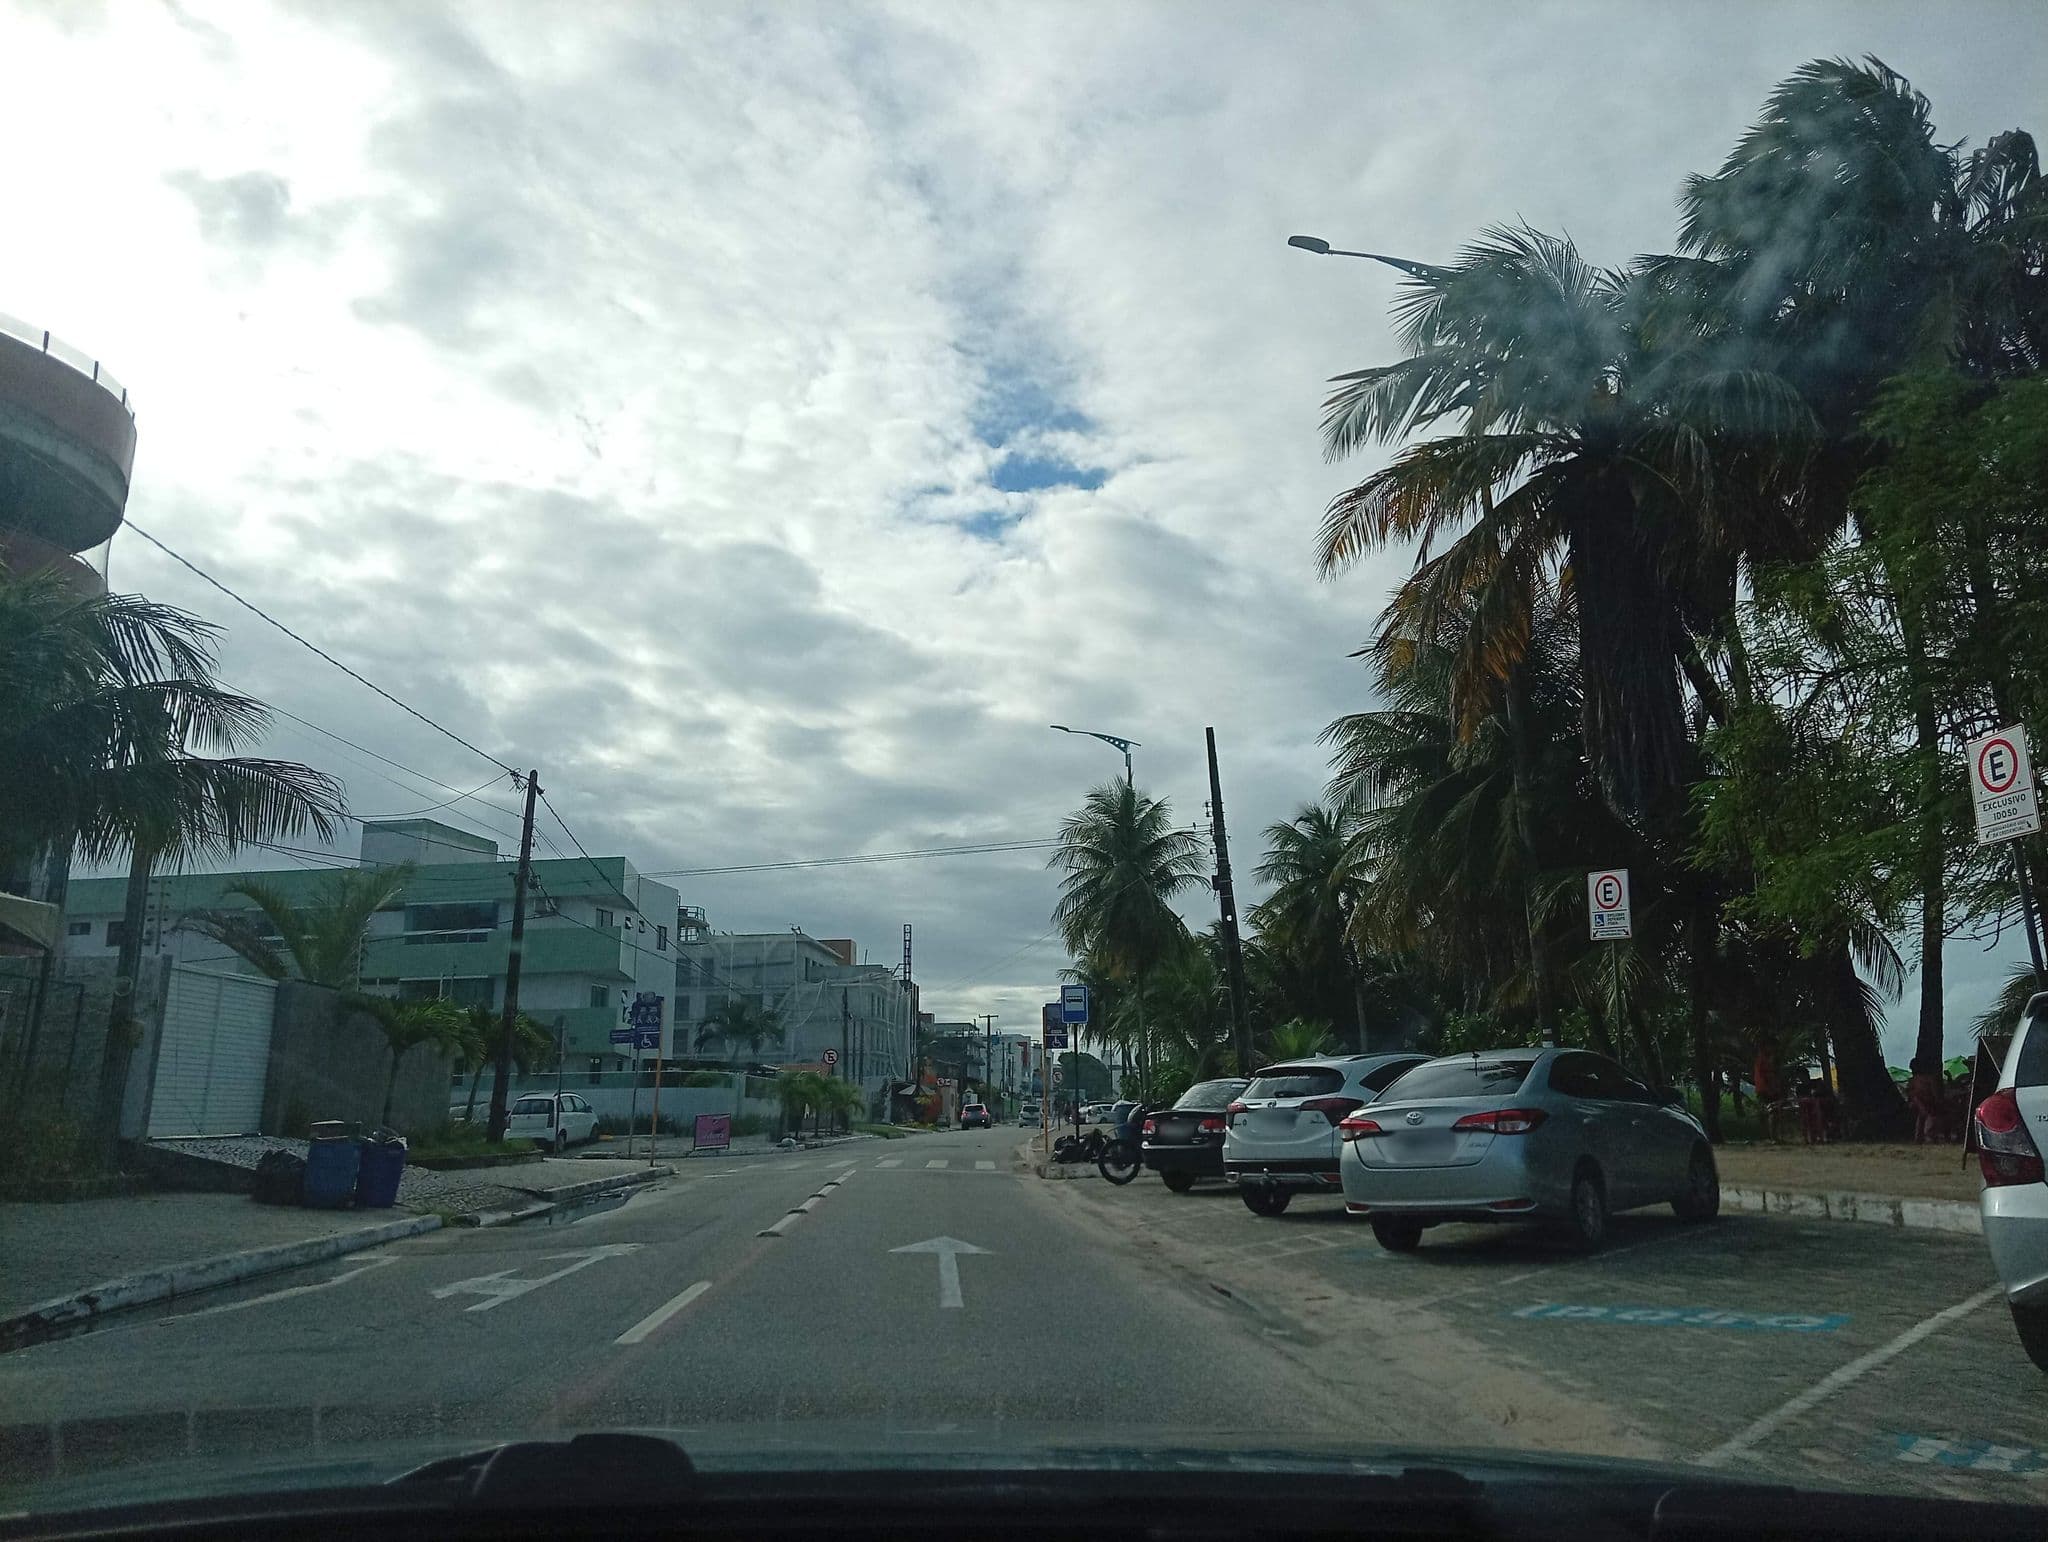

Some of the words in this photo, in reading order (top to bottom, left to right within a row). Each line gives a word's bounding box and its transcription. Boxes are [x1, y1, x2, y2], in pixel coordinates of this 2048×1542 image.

[1989, 750, 2006, 781] E
[1982, 793, 2027, 812] EXCLUSIVO
[1993, 807, 2018, 821] IDOSO
[1603, 882, 1613, 902] E
